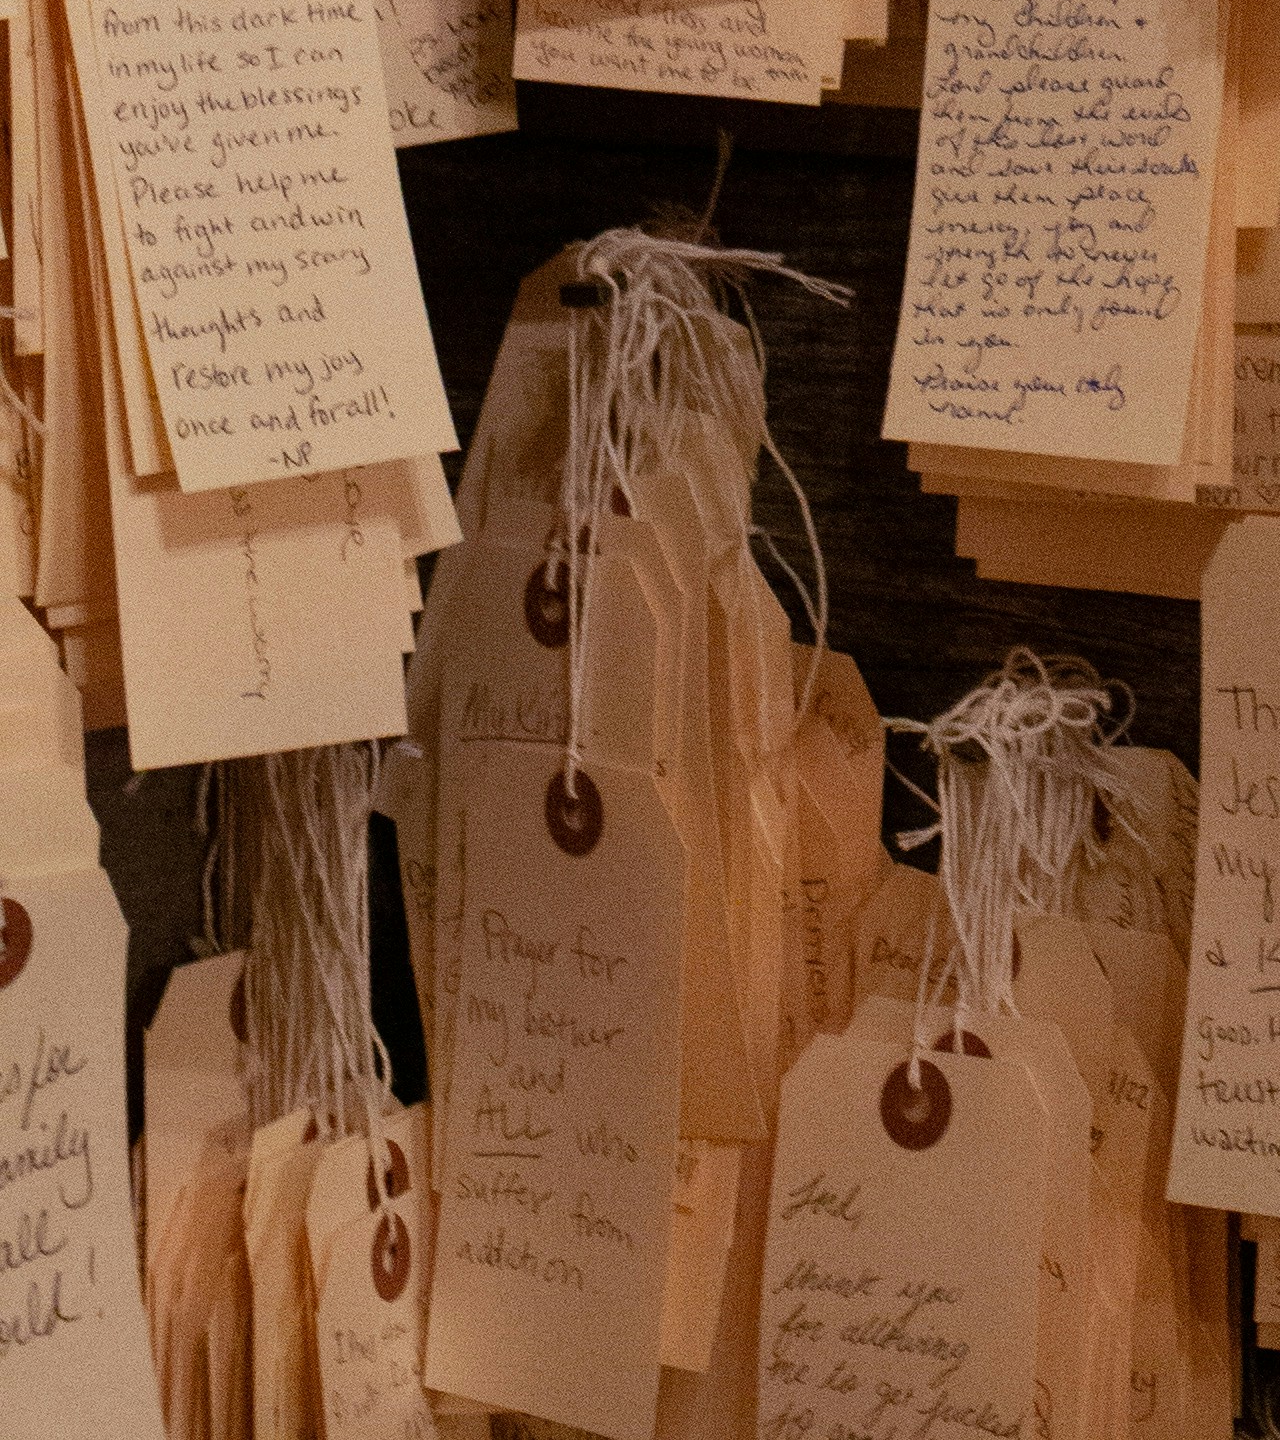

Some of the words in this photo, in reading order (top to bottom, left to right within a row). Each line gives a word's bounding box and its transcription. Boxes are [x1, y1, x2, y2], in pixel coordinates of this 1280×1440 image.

[103, 8, 160, 36] from
[175, 8, 222, 33] this
[232, 10, 298, 30] dark
[307, 3, 361, 22] time
[171, 363, 251, 389] restore
[266, 360, 314, 395] my
[322, 351, 364, 381] joy
